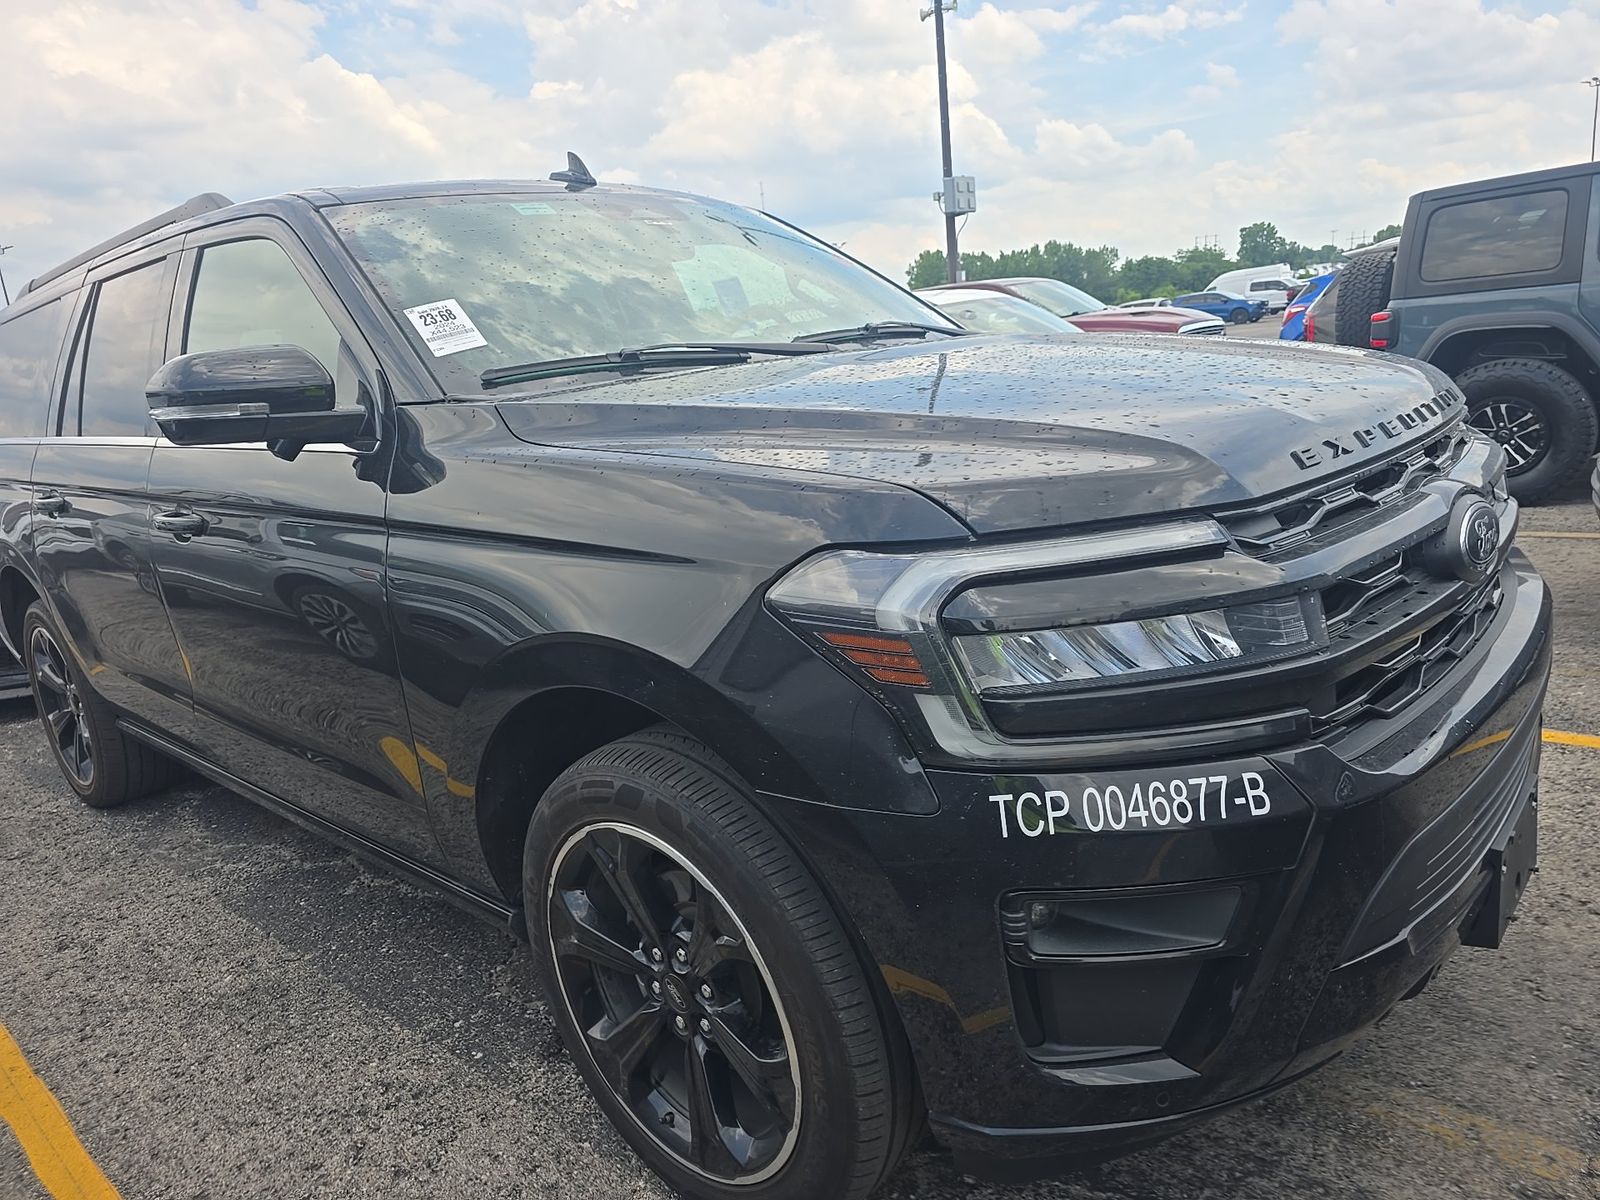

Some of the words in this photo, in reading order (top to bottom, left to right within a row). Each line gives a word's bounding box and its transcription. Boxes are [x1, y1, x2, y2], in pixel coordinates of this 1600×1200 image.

[419, 308, 457, 326] 23:68
[989, 790, 1070, 838] TCP
[1082, 772, 1271, 833] 0046877-B
